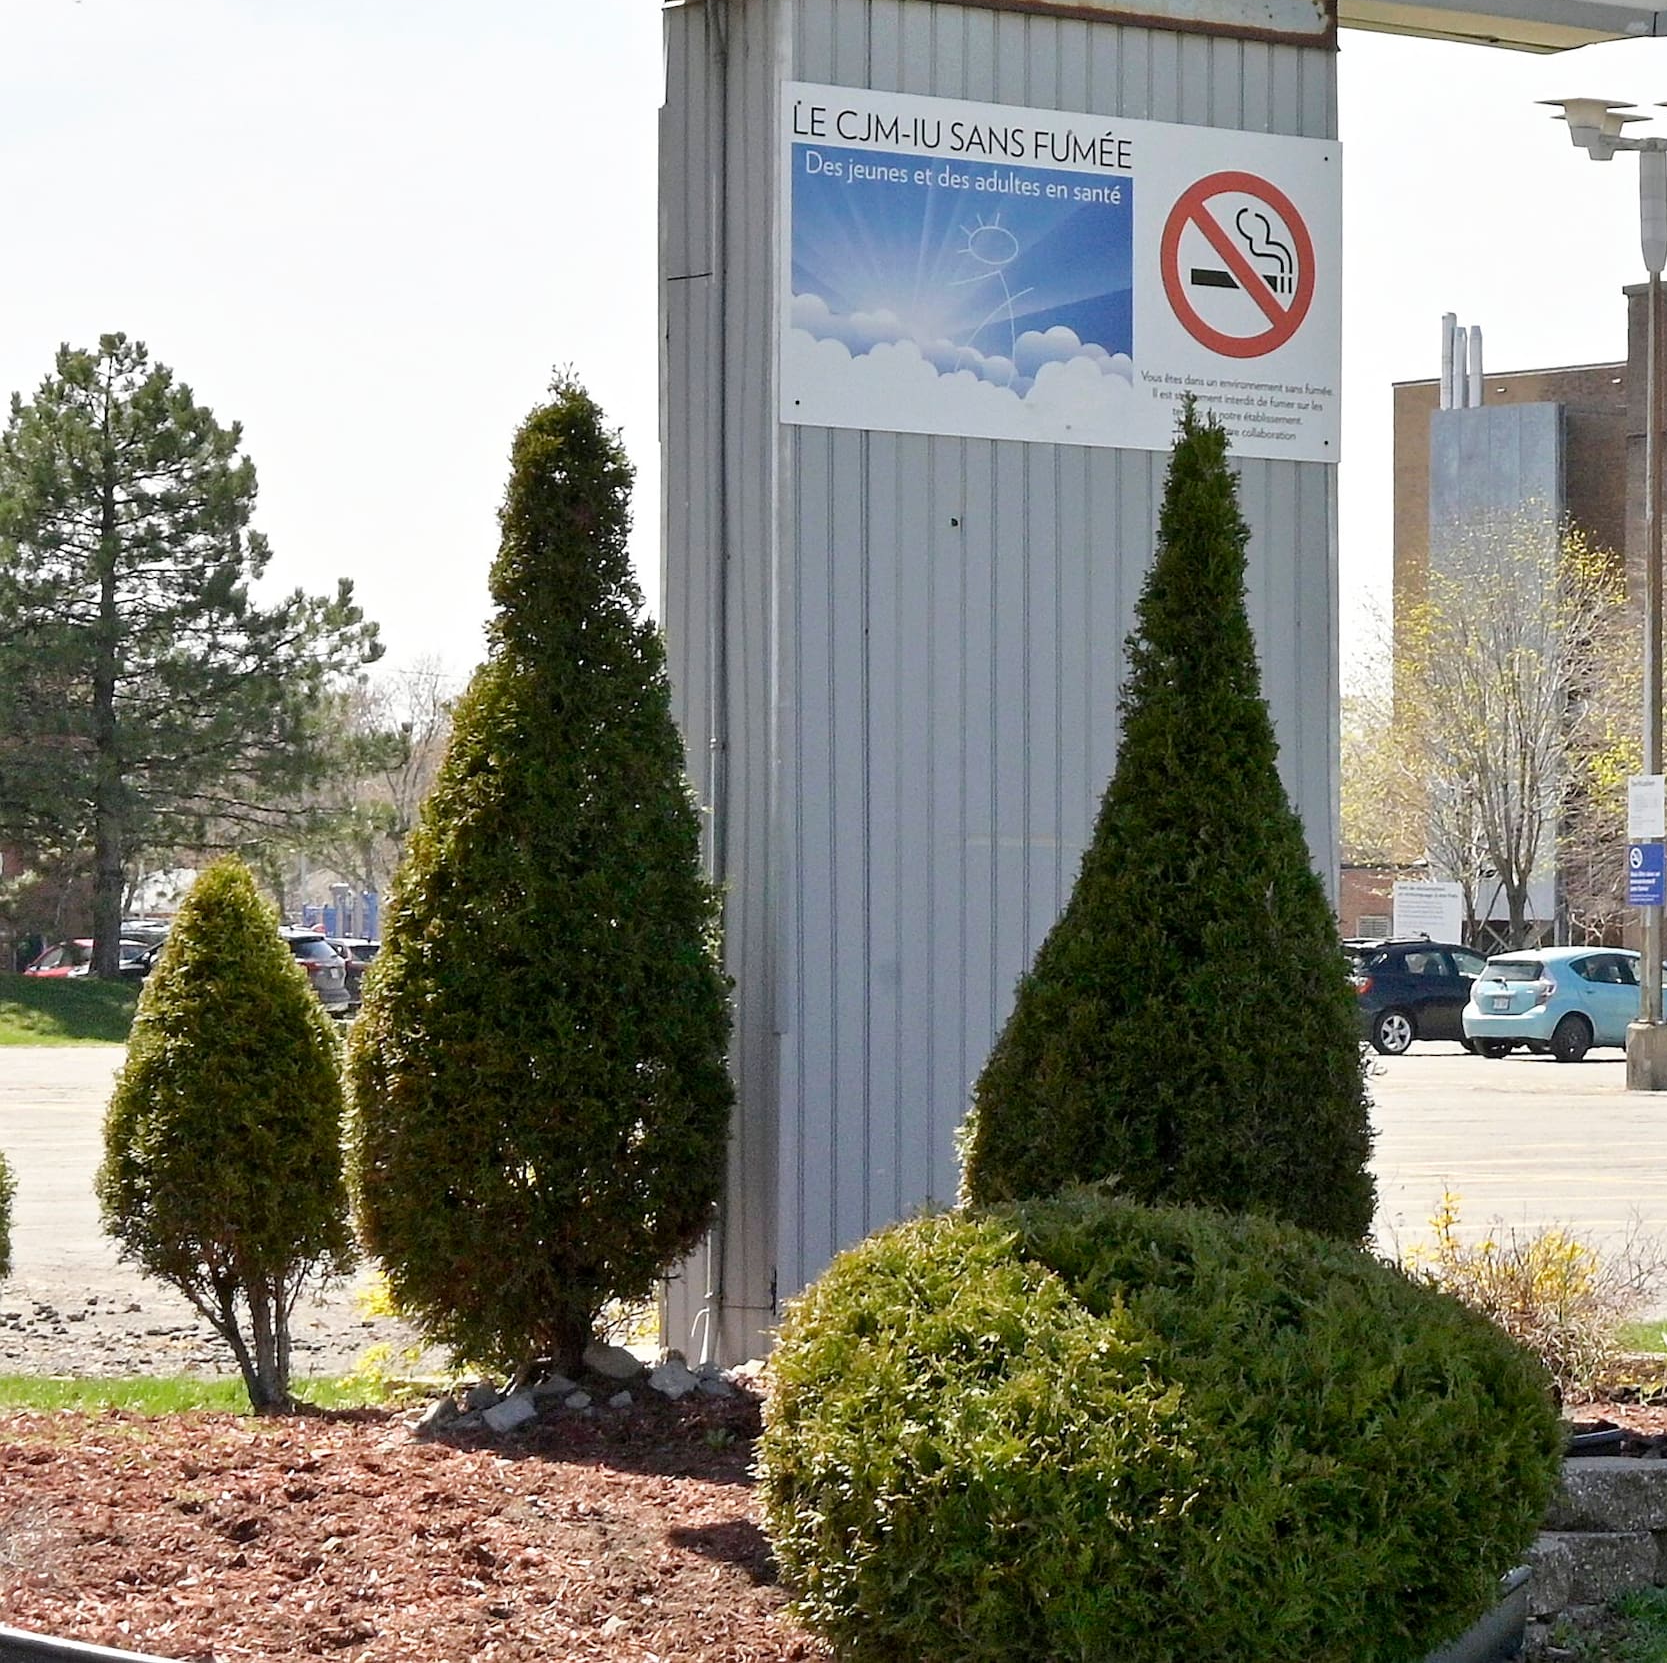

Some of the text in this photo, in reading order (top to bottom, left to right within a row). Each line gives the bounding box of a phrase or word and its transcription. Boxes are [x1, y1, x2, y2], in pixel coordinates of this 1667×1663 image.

[793, 104, 1133, 169] LE CJM-IU SANS FUMÉE
[805, 150, 1121, 204] Des jeunes et des adultes en santé
[1141, 370, 1163, 383] Vous
[1165, 373, 1183, 384] êtes
[1184, 374, 1204, 386] dans
[1220, 380, 1283, 392] environnement
[1285, 385, 1303, 394] sans
[1152, 387, 1158, 398] Il
[1160, 392, 1173, 400] est
[1225, 395, 1255, 406] interdit
[1257, 396, 1268, 407] de
[1270, 396, 1294, 409] fumer
[1297, 402, 1310, 410] sur
[1311, 400, 1323, 412] les
[1219, 411, 1242, 421] notre
[1242, 428, 1297, 440] collaboration
